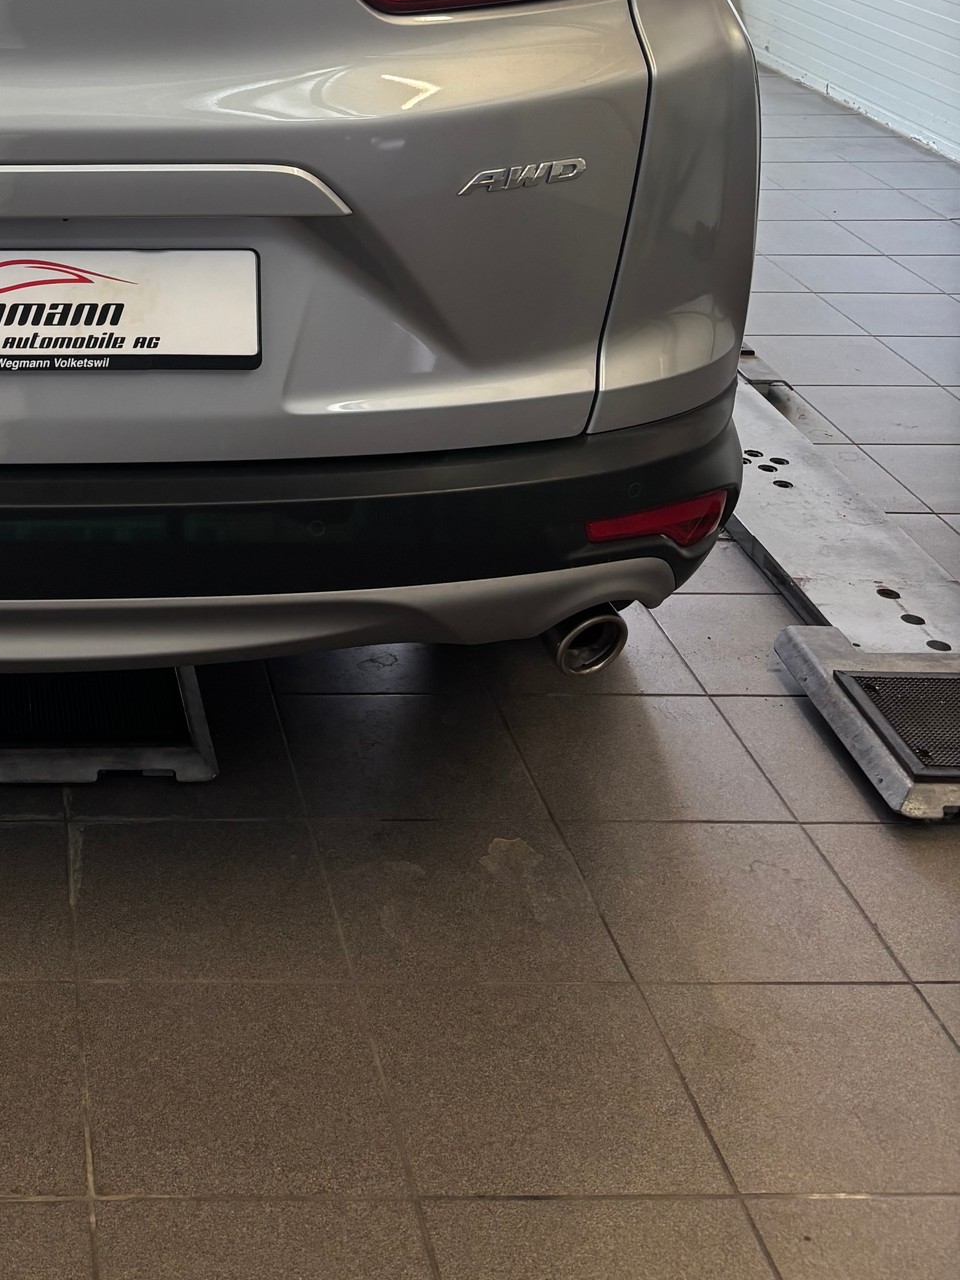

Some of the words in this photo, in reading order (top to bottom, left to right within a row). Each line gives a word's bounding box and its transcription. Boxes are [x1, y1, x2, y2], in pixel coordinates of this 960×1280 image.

[457, 157, 587, 195] AWD
[132, 336, 161, 349] AG
[54, 357, 110, 368] Volketswil
